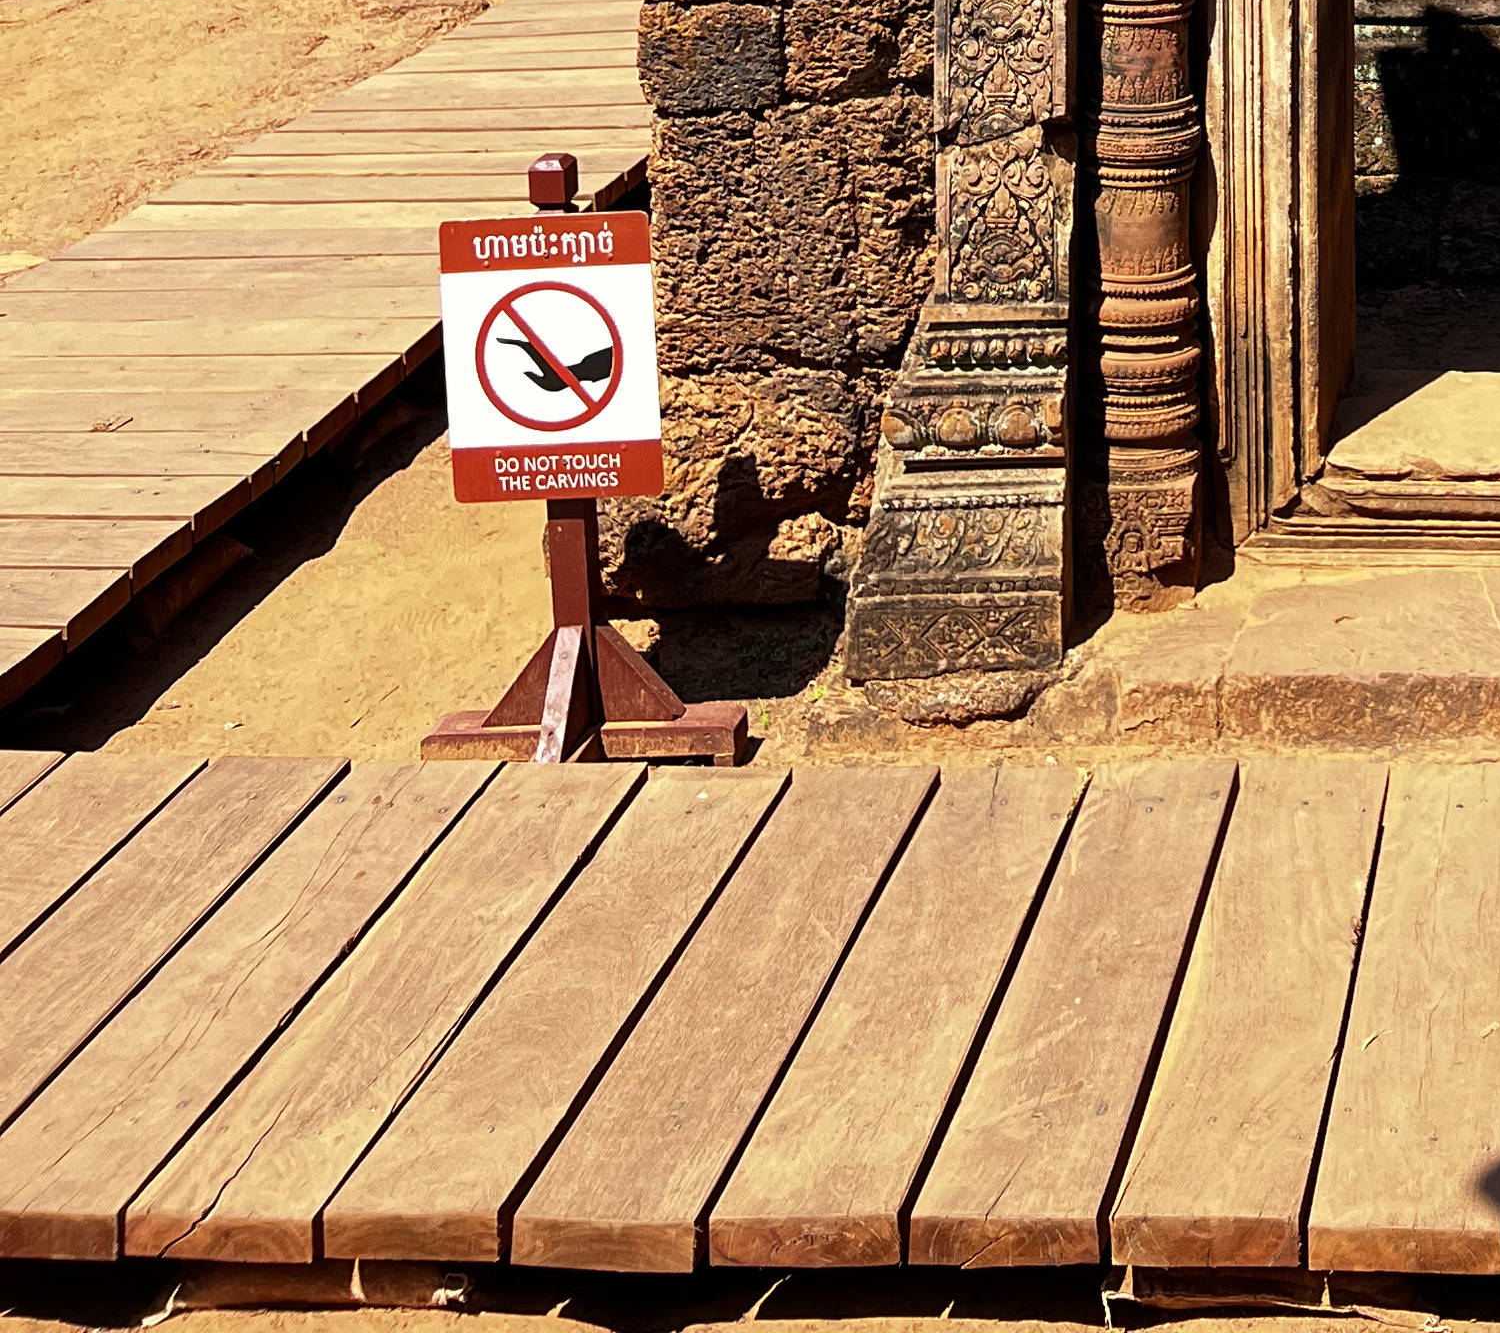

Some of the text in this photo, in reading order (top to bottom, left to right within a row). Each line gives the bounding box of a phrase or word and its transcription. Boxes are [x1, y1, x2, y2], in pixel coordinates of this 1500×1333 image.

[494, 454, 620, 473] DO NOT TOUCH
[499, 472, 618, 491] THE CARVINGS
